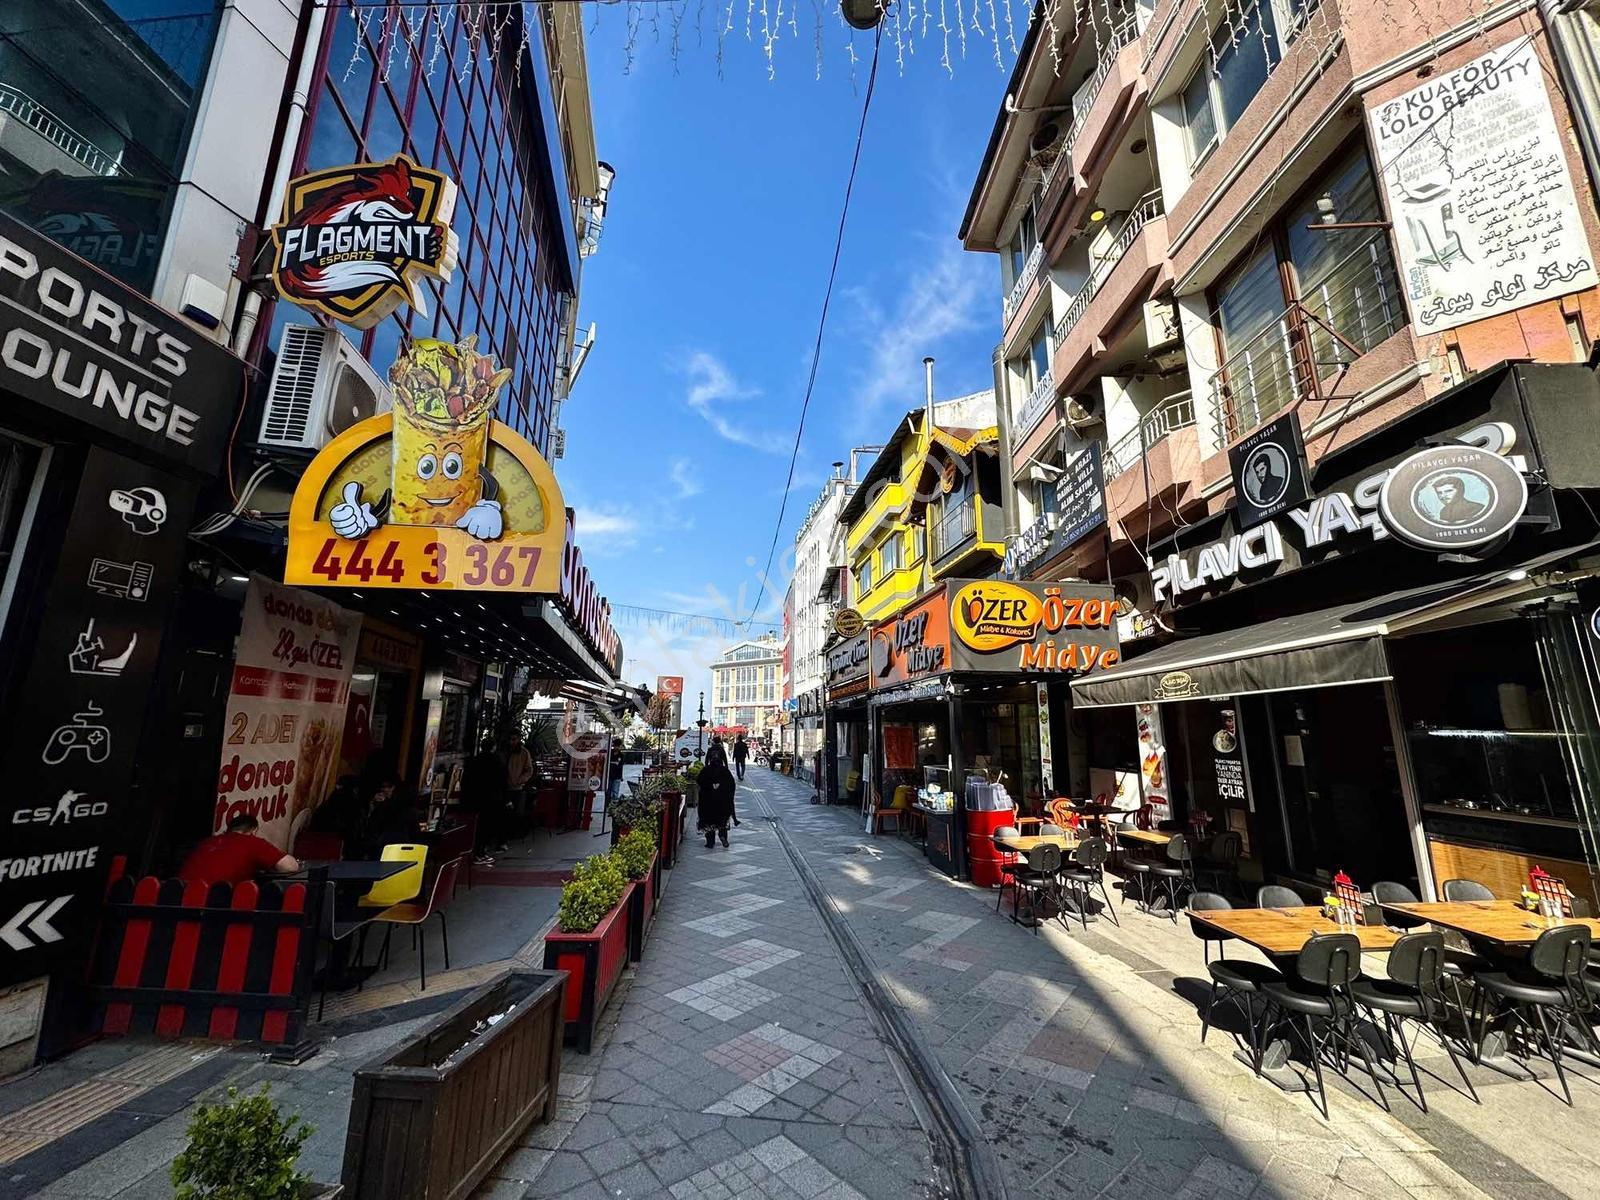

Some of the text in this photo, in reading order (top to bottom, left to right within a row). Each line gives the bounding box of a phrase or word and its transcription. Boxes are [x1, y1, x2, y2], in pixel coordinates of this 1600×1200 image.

[1379, 105, 1434, 140] LOLO
[1442, 58, 1531, 113] BEAUTY
[1405, 58, 1494, 112] KUAFÖR
[281, 224, 432, 268] FLAGMENT
[320, 250, 376, 266] ESPORTS
[1482, 273, 1526, 308] لولو
[312, 537, 542, 587] 444 3 367
[962, 589, 1027, 628] ÖZER
[1042, 587, 1119, 632] Özer
[1019, 641, 1119, 672] Midye
[228, 712, 248, 745] 2
[217, 754, 295, 795] donas
[0, 846, 99, 882] FORTNITE
